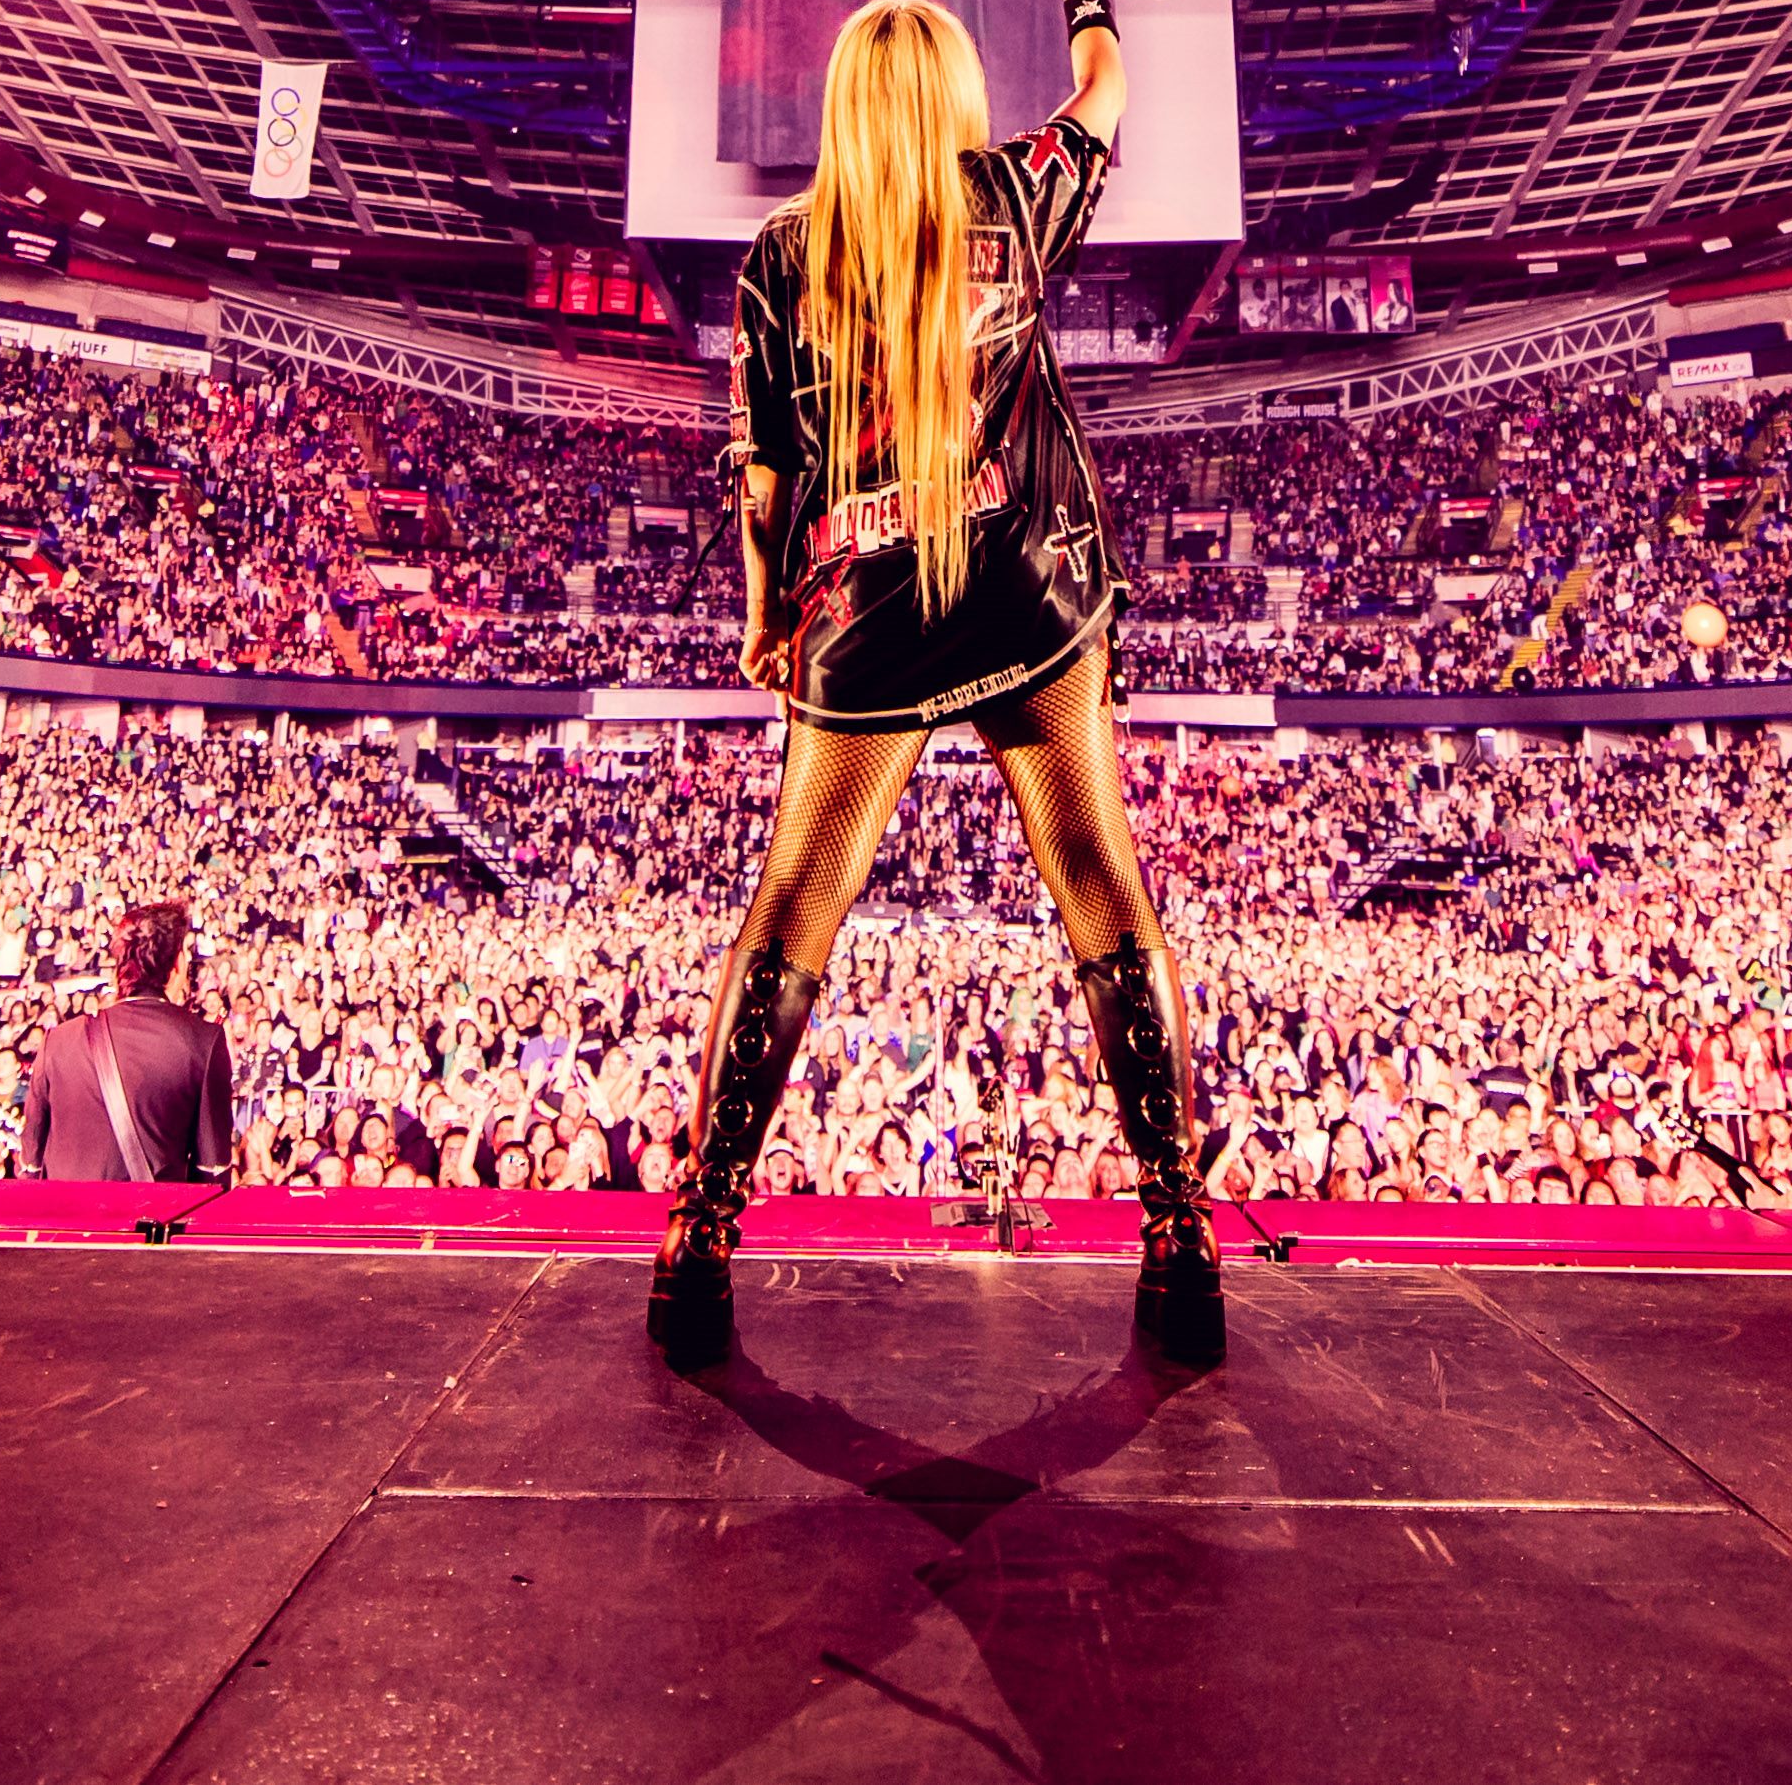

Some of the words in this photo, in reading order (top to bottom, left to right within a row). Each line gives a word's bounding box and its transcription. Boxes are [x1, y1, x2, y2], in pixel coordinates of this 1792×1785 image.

[71, 340, 108, 356] HUFF
[1266, 404, 1301, 419] ROUGH
[1303, 402, 1337, 417] HOUSE
[917, 697, 939, 723] MY
[936, 680, 979, 714] HAPPY
[978, 662, 1029, 696] ENDING
